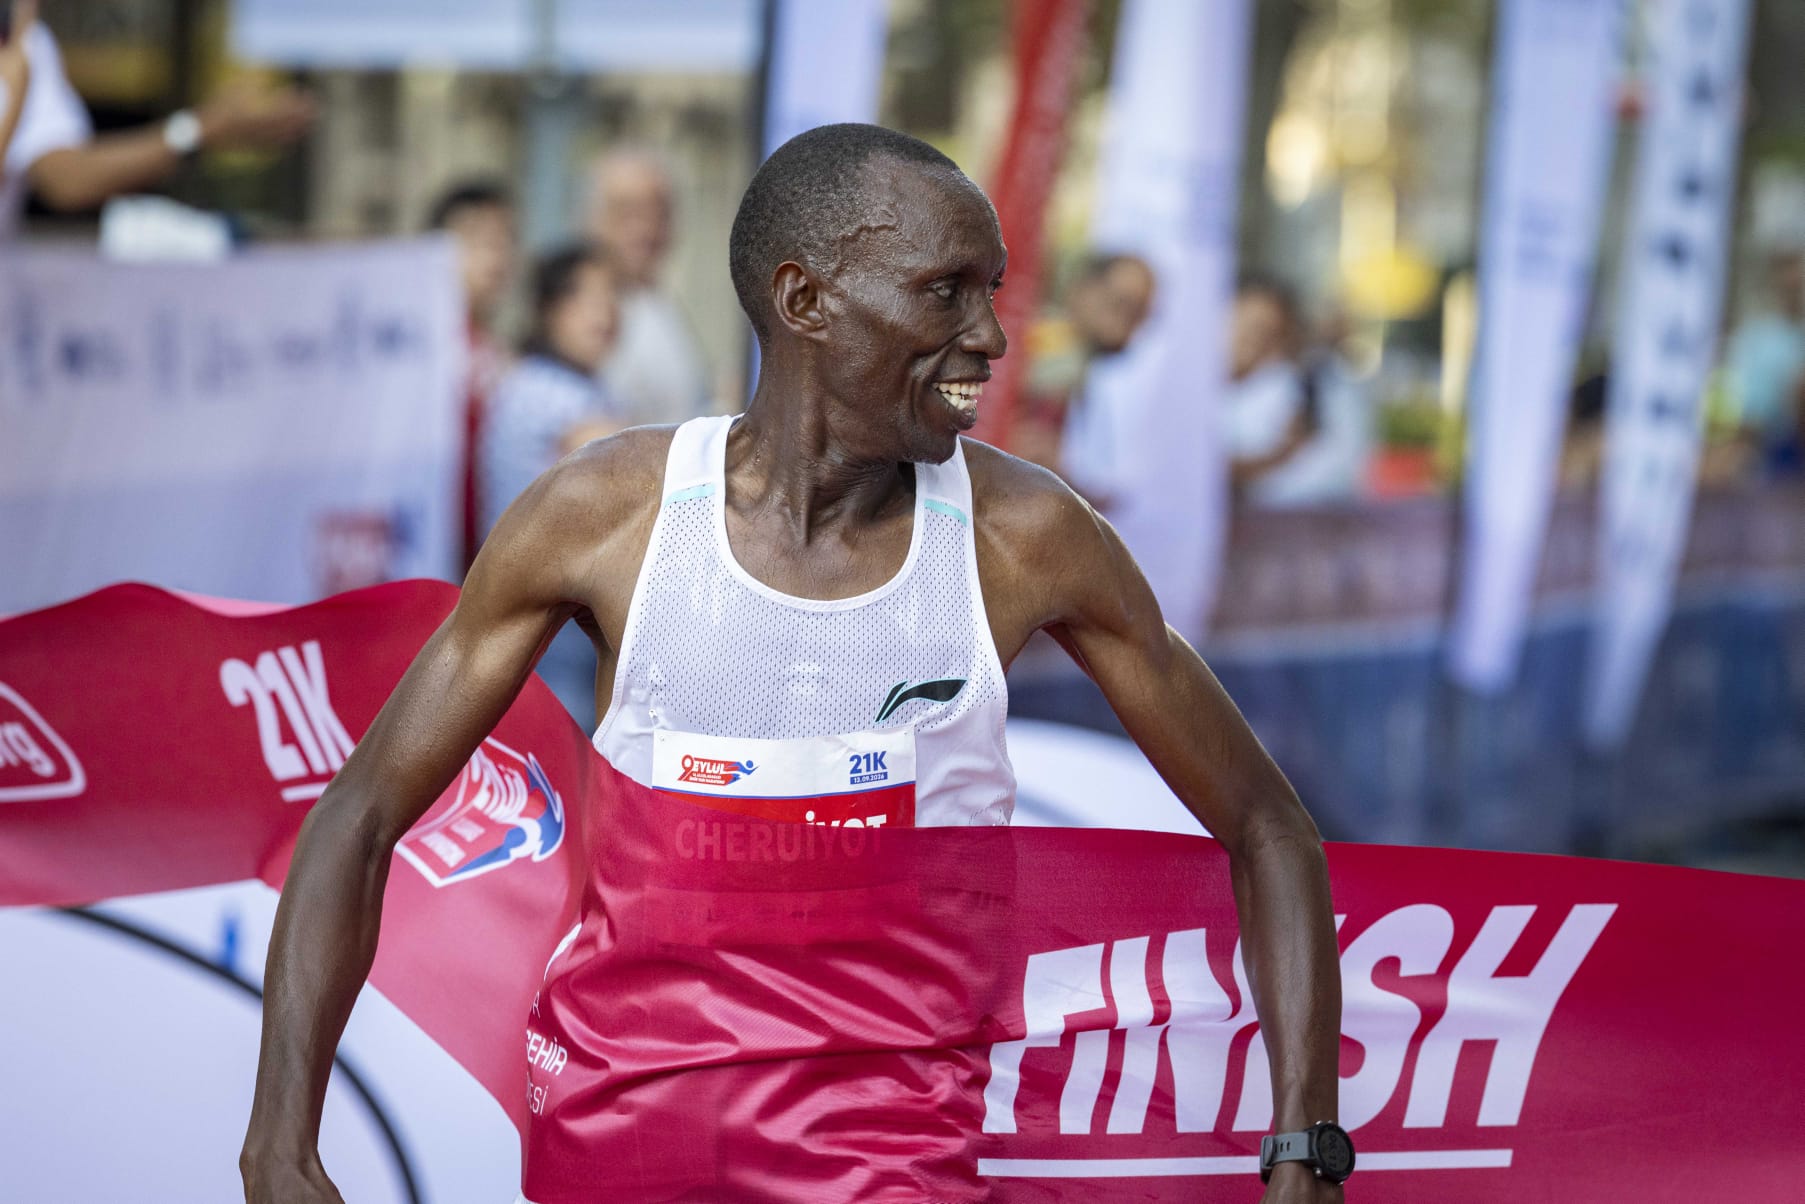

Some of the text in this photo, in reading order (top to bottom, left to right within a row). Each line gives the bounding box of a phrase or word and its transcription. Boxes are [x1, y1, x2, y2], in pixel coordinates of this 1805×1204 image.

[219, 639, 357, 782] 21K
[849, 750, 888, 775] 21K
[526, 1029, 568, 1076] EHİR
